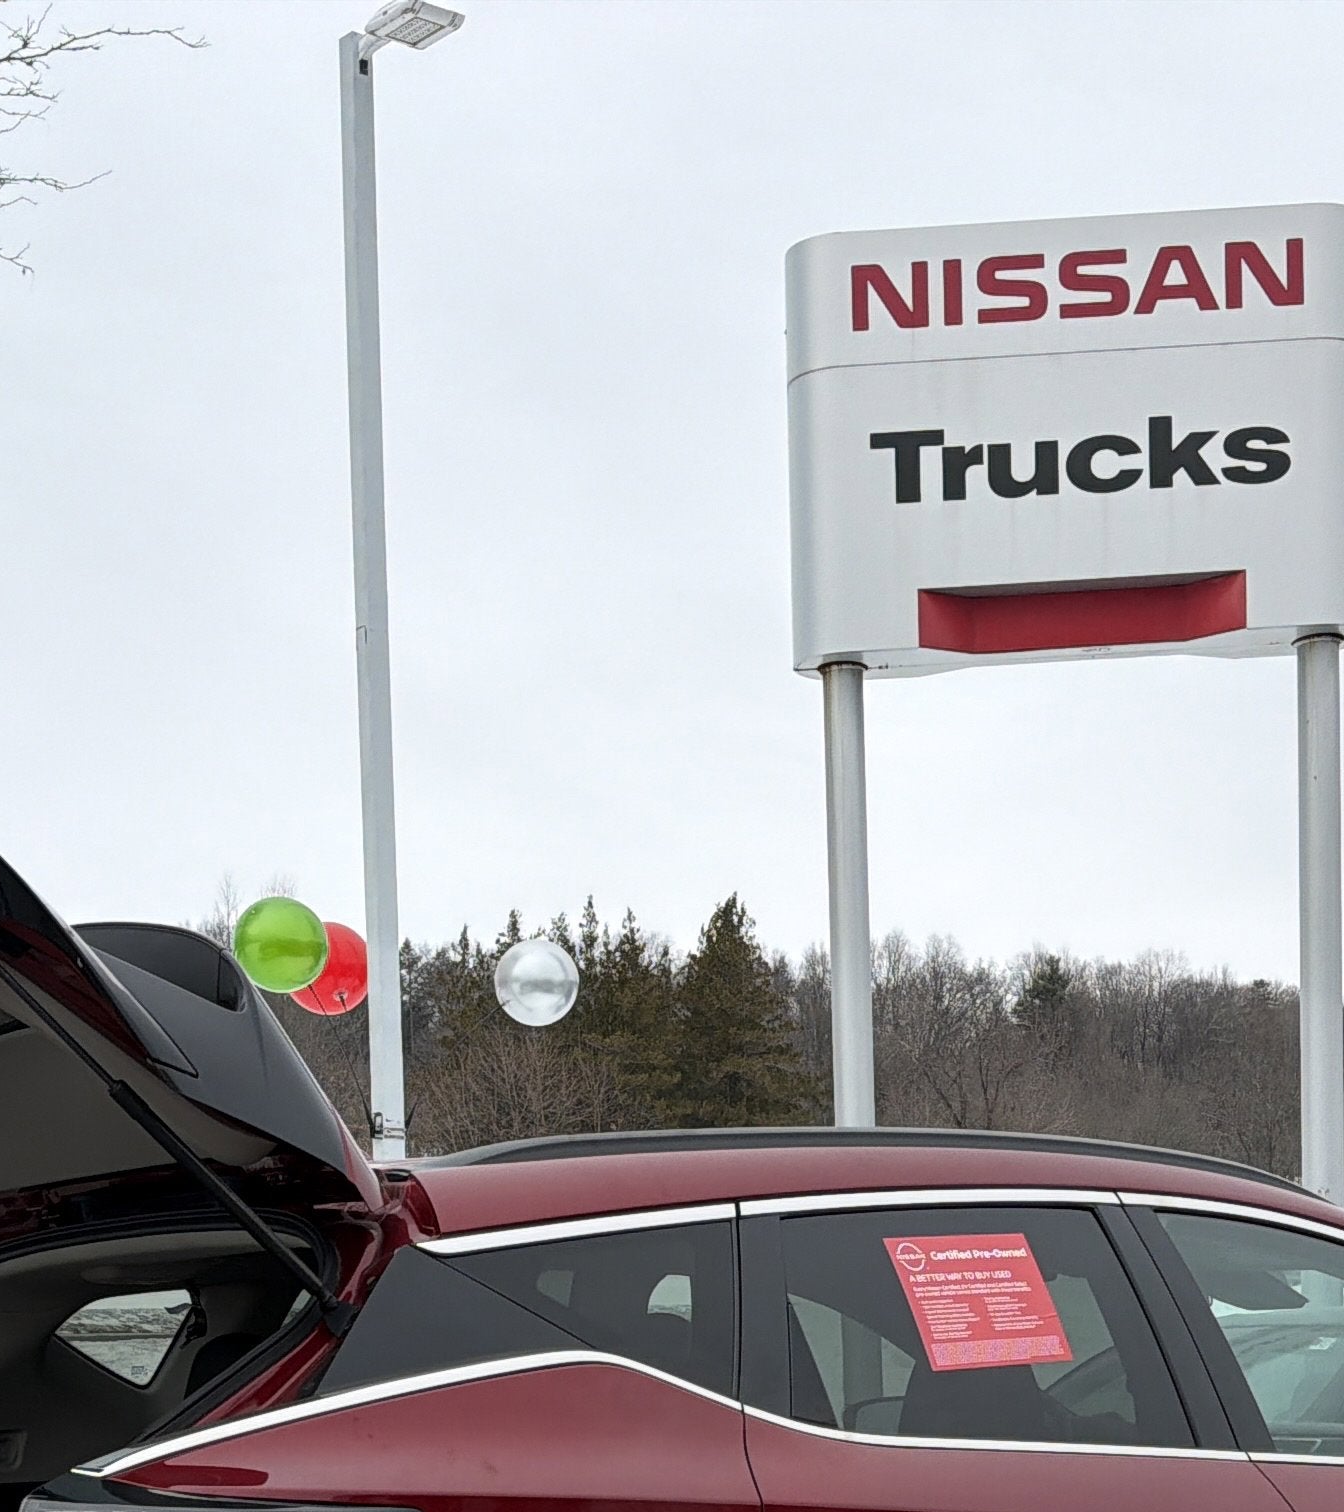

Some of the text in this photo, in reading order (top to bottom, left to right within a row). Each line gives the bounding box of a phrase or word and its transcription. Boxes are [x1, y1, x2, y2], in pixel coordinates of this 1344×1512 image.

[851, 238, 1305, 332] NISSAN
[869, 415, 1292, 504] Trucks
[916, 1273, 946, 1283] BETTER
[946, 1272, 962, 1281] WAY
[962, 1271, 974, 1280] TO
[975, 1271, 991, 1280] BUY
[991, 1270, 1012, 1279] USED
[930, 1247, 1027, 1260] Certified Pre-Owned
